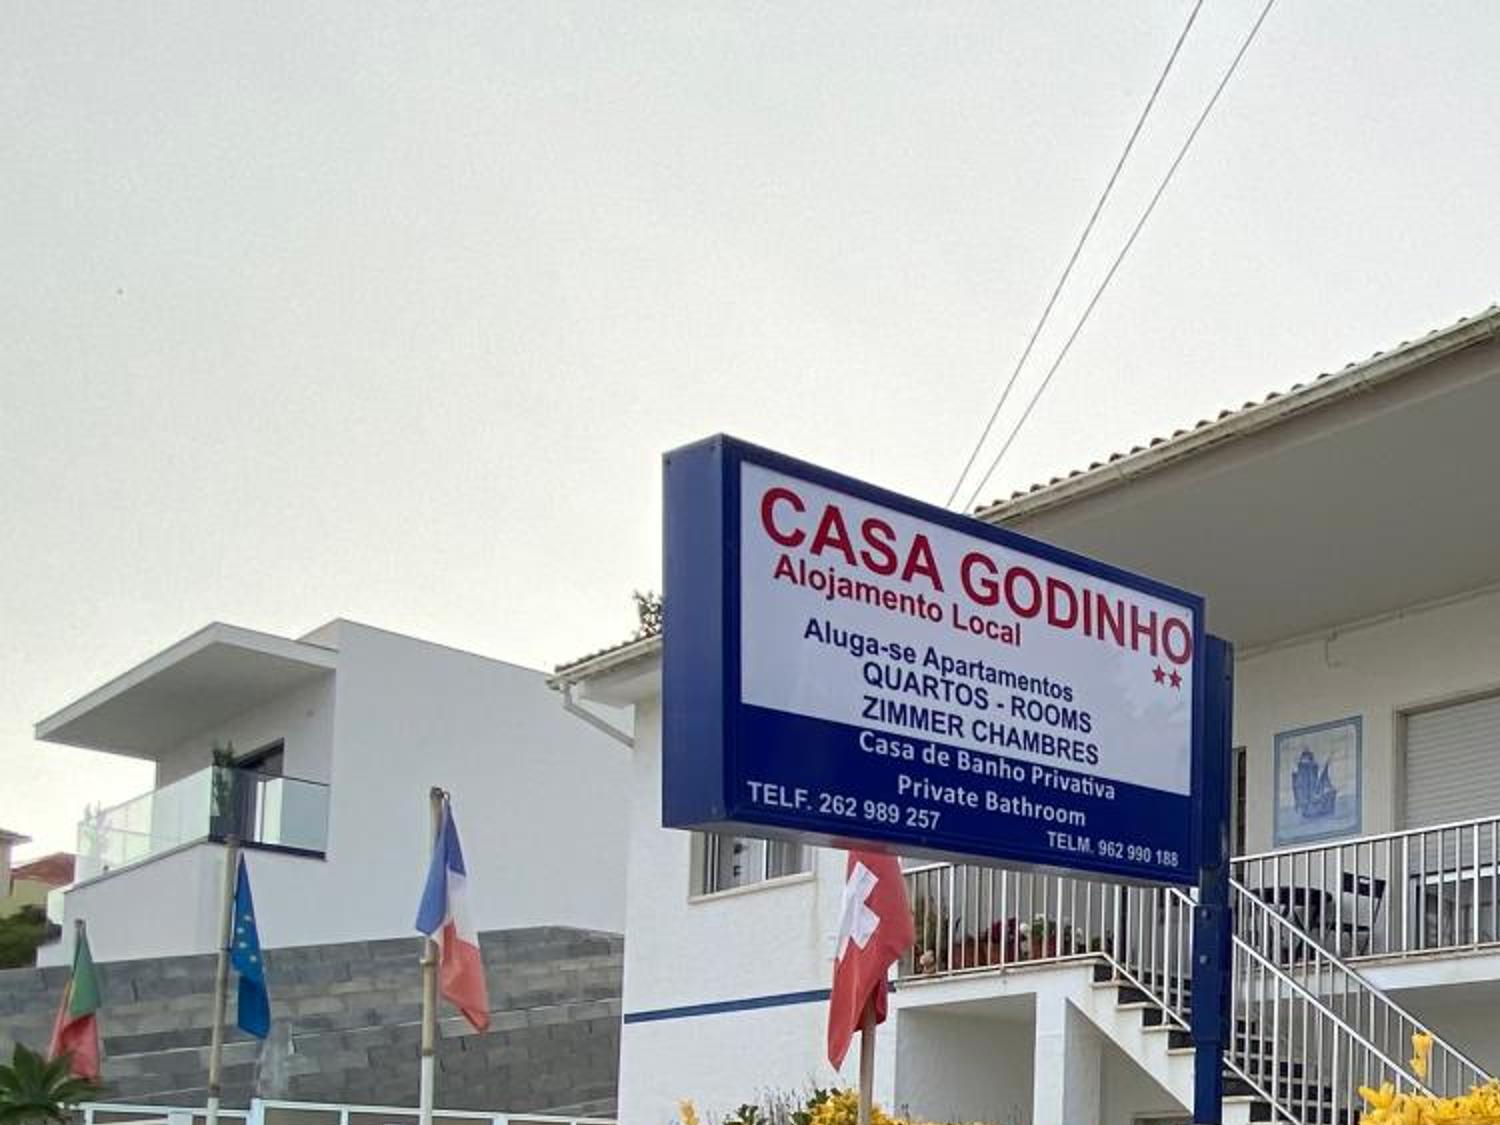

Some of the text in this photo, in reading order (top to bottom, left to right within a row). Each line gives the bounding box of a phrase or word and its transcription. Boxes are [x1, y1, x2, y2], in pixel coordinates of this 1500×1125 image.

[761, 487, 1192, 665] CASA GODINHO
[773, 554, 1021, 647] Alojamento Local
[804, 618, 1073, 702] Aluga-se Apartamentos
[862, 695, 1099, 765] ZIMMER CHAMBRES
[863, 661, 989, 710] QUARTOS
[1011, 695, 1092, 733] ROOMS
[859, 731, 1116, 800] Casa de Banho Privativa
[898, 774, 1086, 827] Private Bathroom
[747, 781, 941, 830] TELF. 262 989 257
[1047, 831, 1179, 867] TELM. 962 990 188
